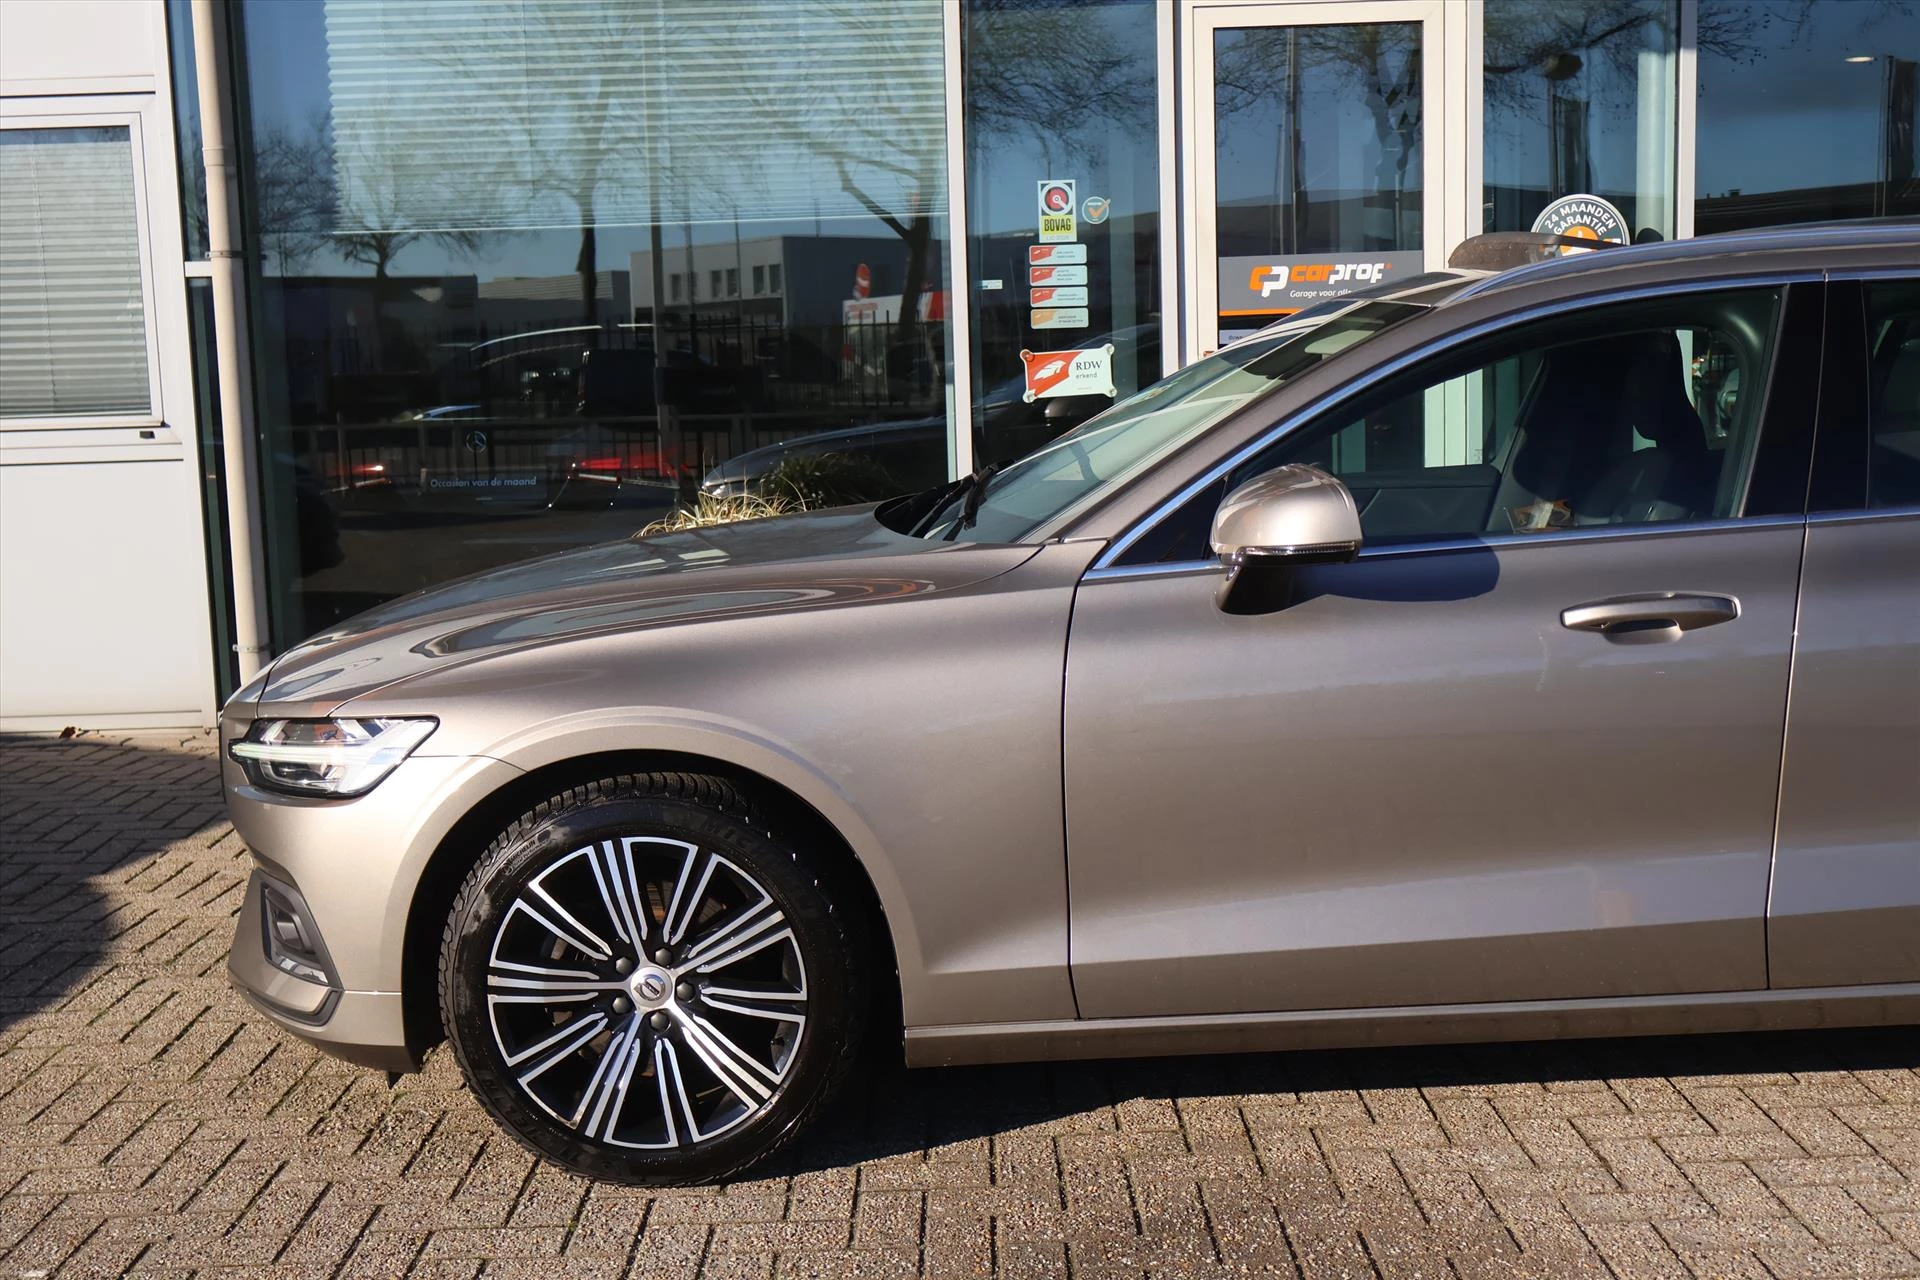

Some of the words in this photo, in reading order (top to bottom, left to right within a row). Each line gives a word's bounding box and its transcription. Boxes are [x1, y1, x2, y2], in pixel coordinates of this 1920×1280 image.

[1544, 213, 1559, 229] 24
[1560, 203, 1617, 229] MAANDEN
[1044, 218, 1072, 232] BOVAG
[1553, 215, 1607, 236] GARANTIE
[1290, 289, 1317, 299] Garage
[1076, 360, 1103, 371] RDW
[1075, 371, 1098, 380] erkend
[430, 478, 470, 488] Occasion
[471, 479, 489, 487] van
[490, 477, 502, 487] de
[503, 476, 537, 486] maand
